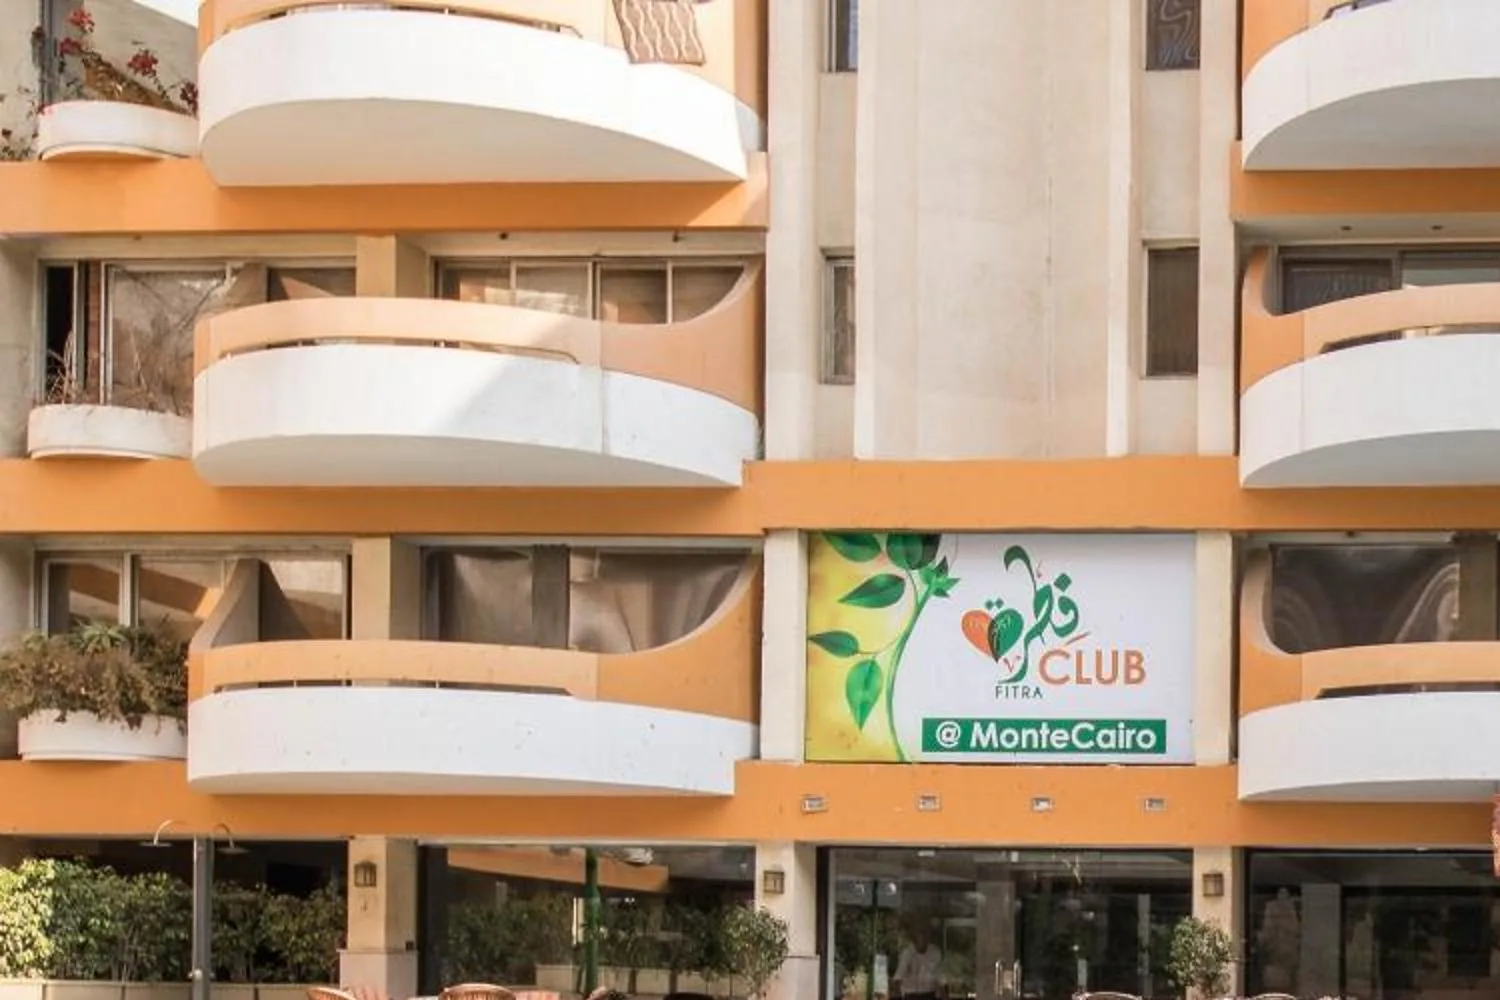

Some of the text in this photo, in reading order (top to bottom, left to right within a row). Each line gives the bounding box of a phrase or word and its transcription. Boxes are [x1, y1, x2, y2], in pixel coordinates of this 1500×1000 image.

[1039, 649, 1146, 685] CLUB
[995, 685, 1043, 699] FITRA
[935, 721, 1156, 749] @ MonteCairo
